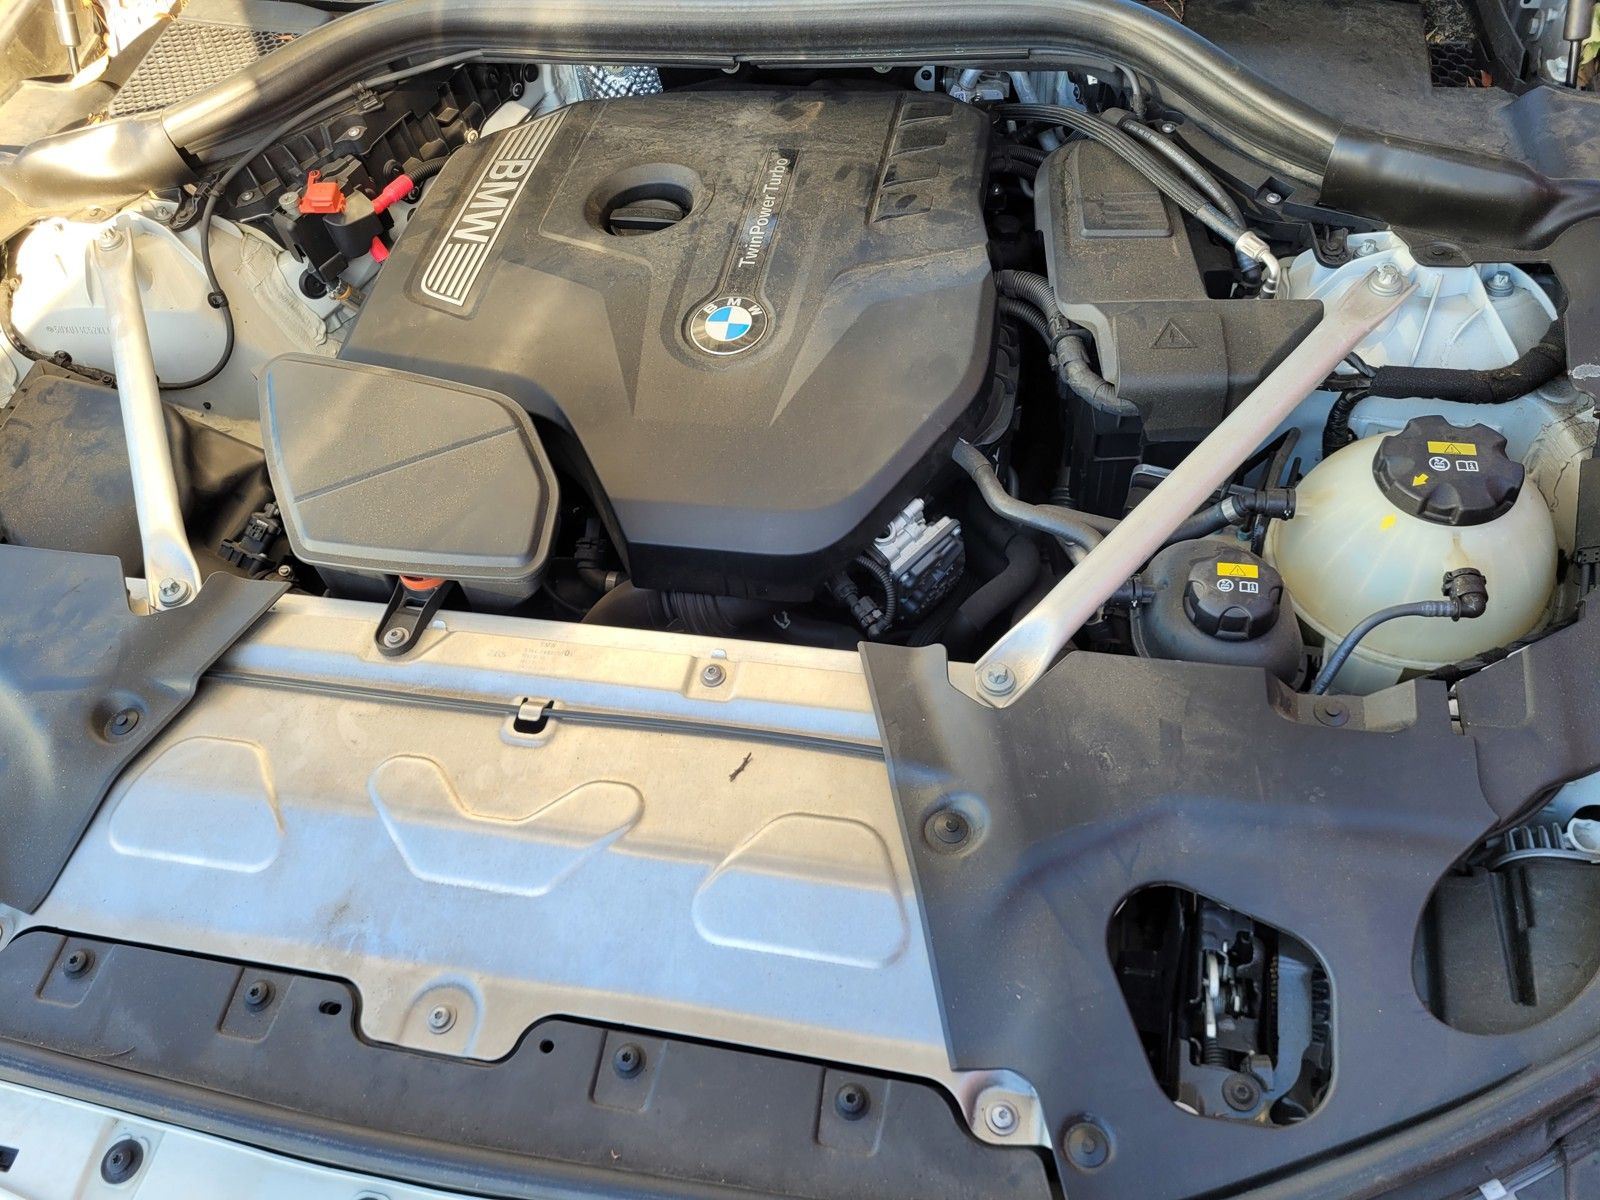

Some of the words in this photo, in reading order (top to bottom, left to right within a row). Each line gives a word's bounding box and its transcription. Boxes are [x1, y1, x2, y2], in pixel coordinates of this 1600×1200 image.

[453, 159, 533, 243] BMW
[739, 194, 776, 268] TwinPower
[763, 158, 788, 193] Turbo
[703, 297, 763, 316] BMW
